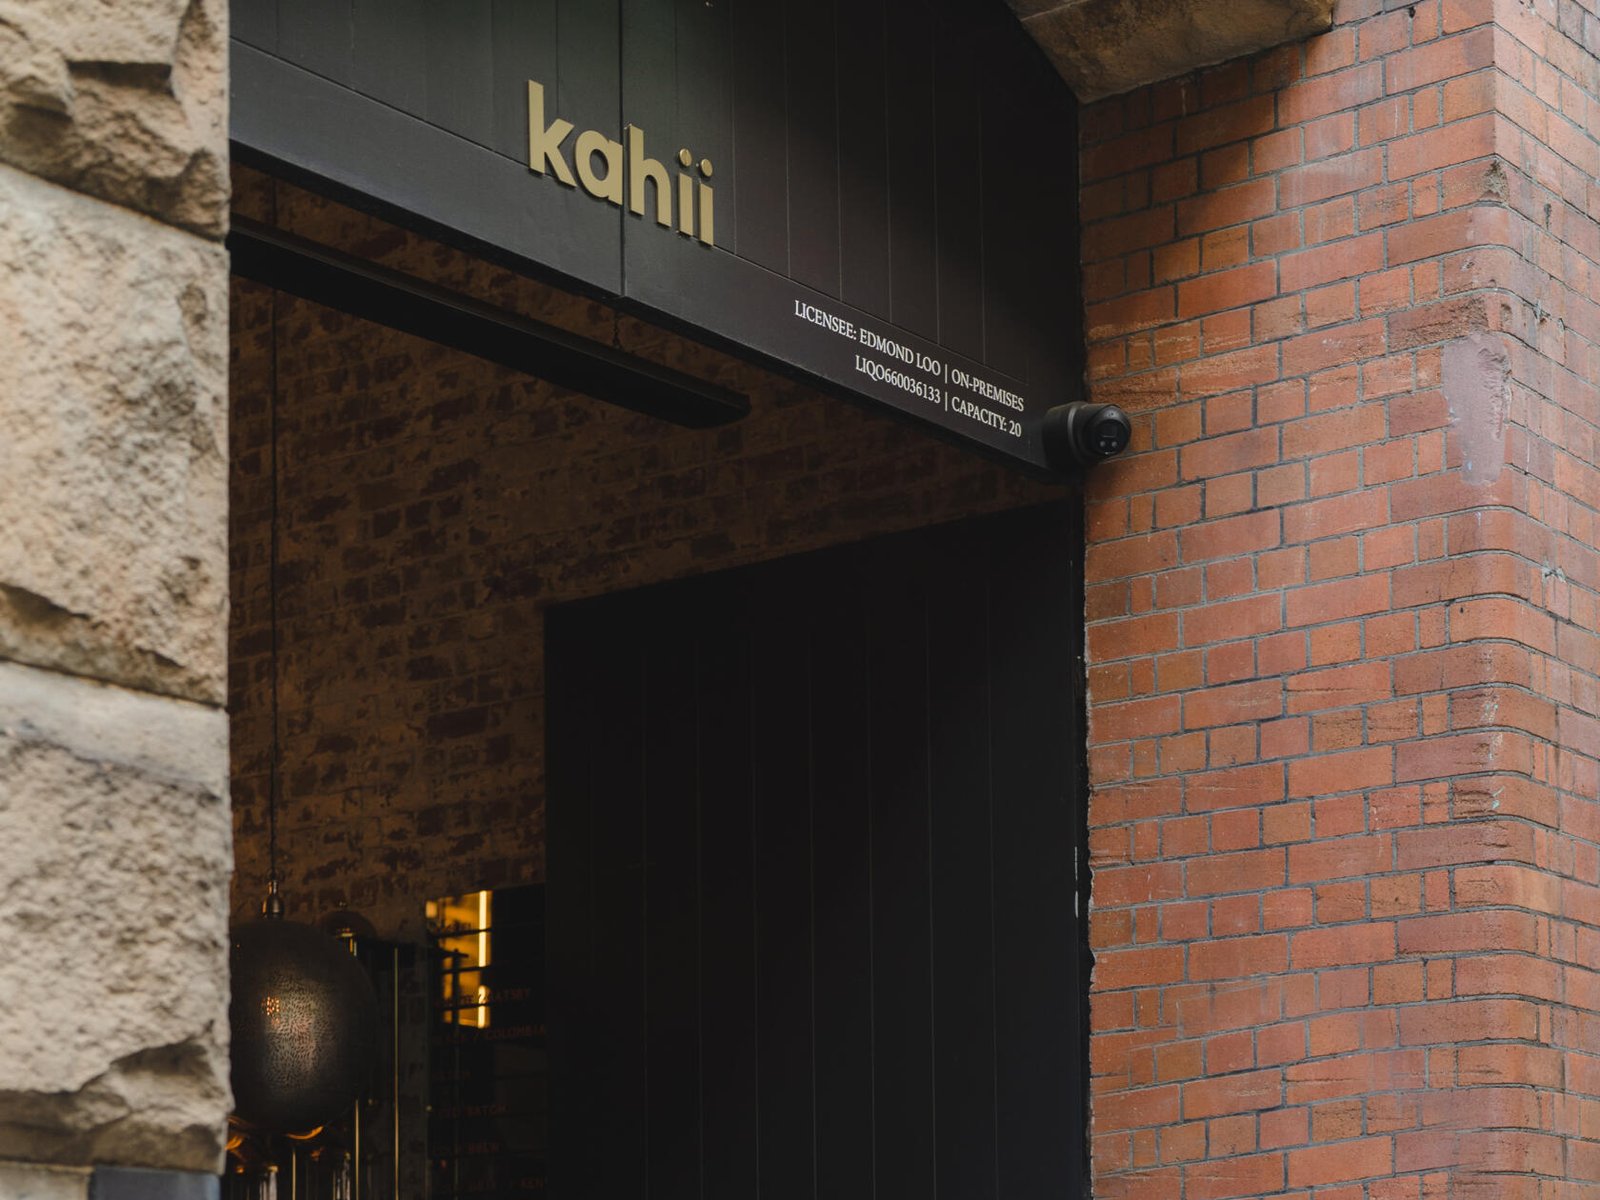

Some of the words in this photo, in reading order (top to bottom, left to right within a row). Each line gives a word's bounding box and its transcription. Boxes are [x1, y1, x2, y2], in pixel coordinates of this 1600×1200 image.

[528, 79, 714, 247] kahii
[795, 300, 857, 341] LICENSEE:
[859, 327, 914, 364] EDMOND
[917, 353, 941, 376] LOO
[952, 368, 1025, 412] ON-PREMISES
[951, 396, 1007, 432] CAPACITY:
[1009, 420, 1023, 438] 20
